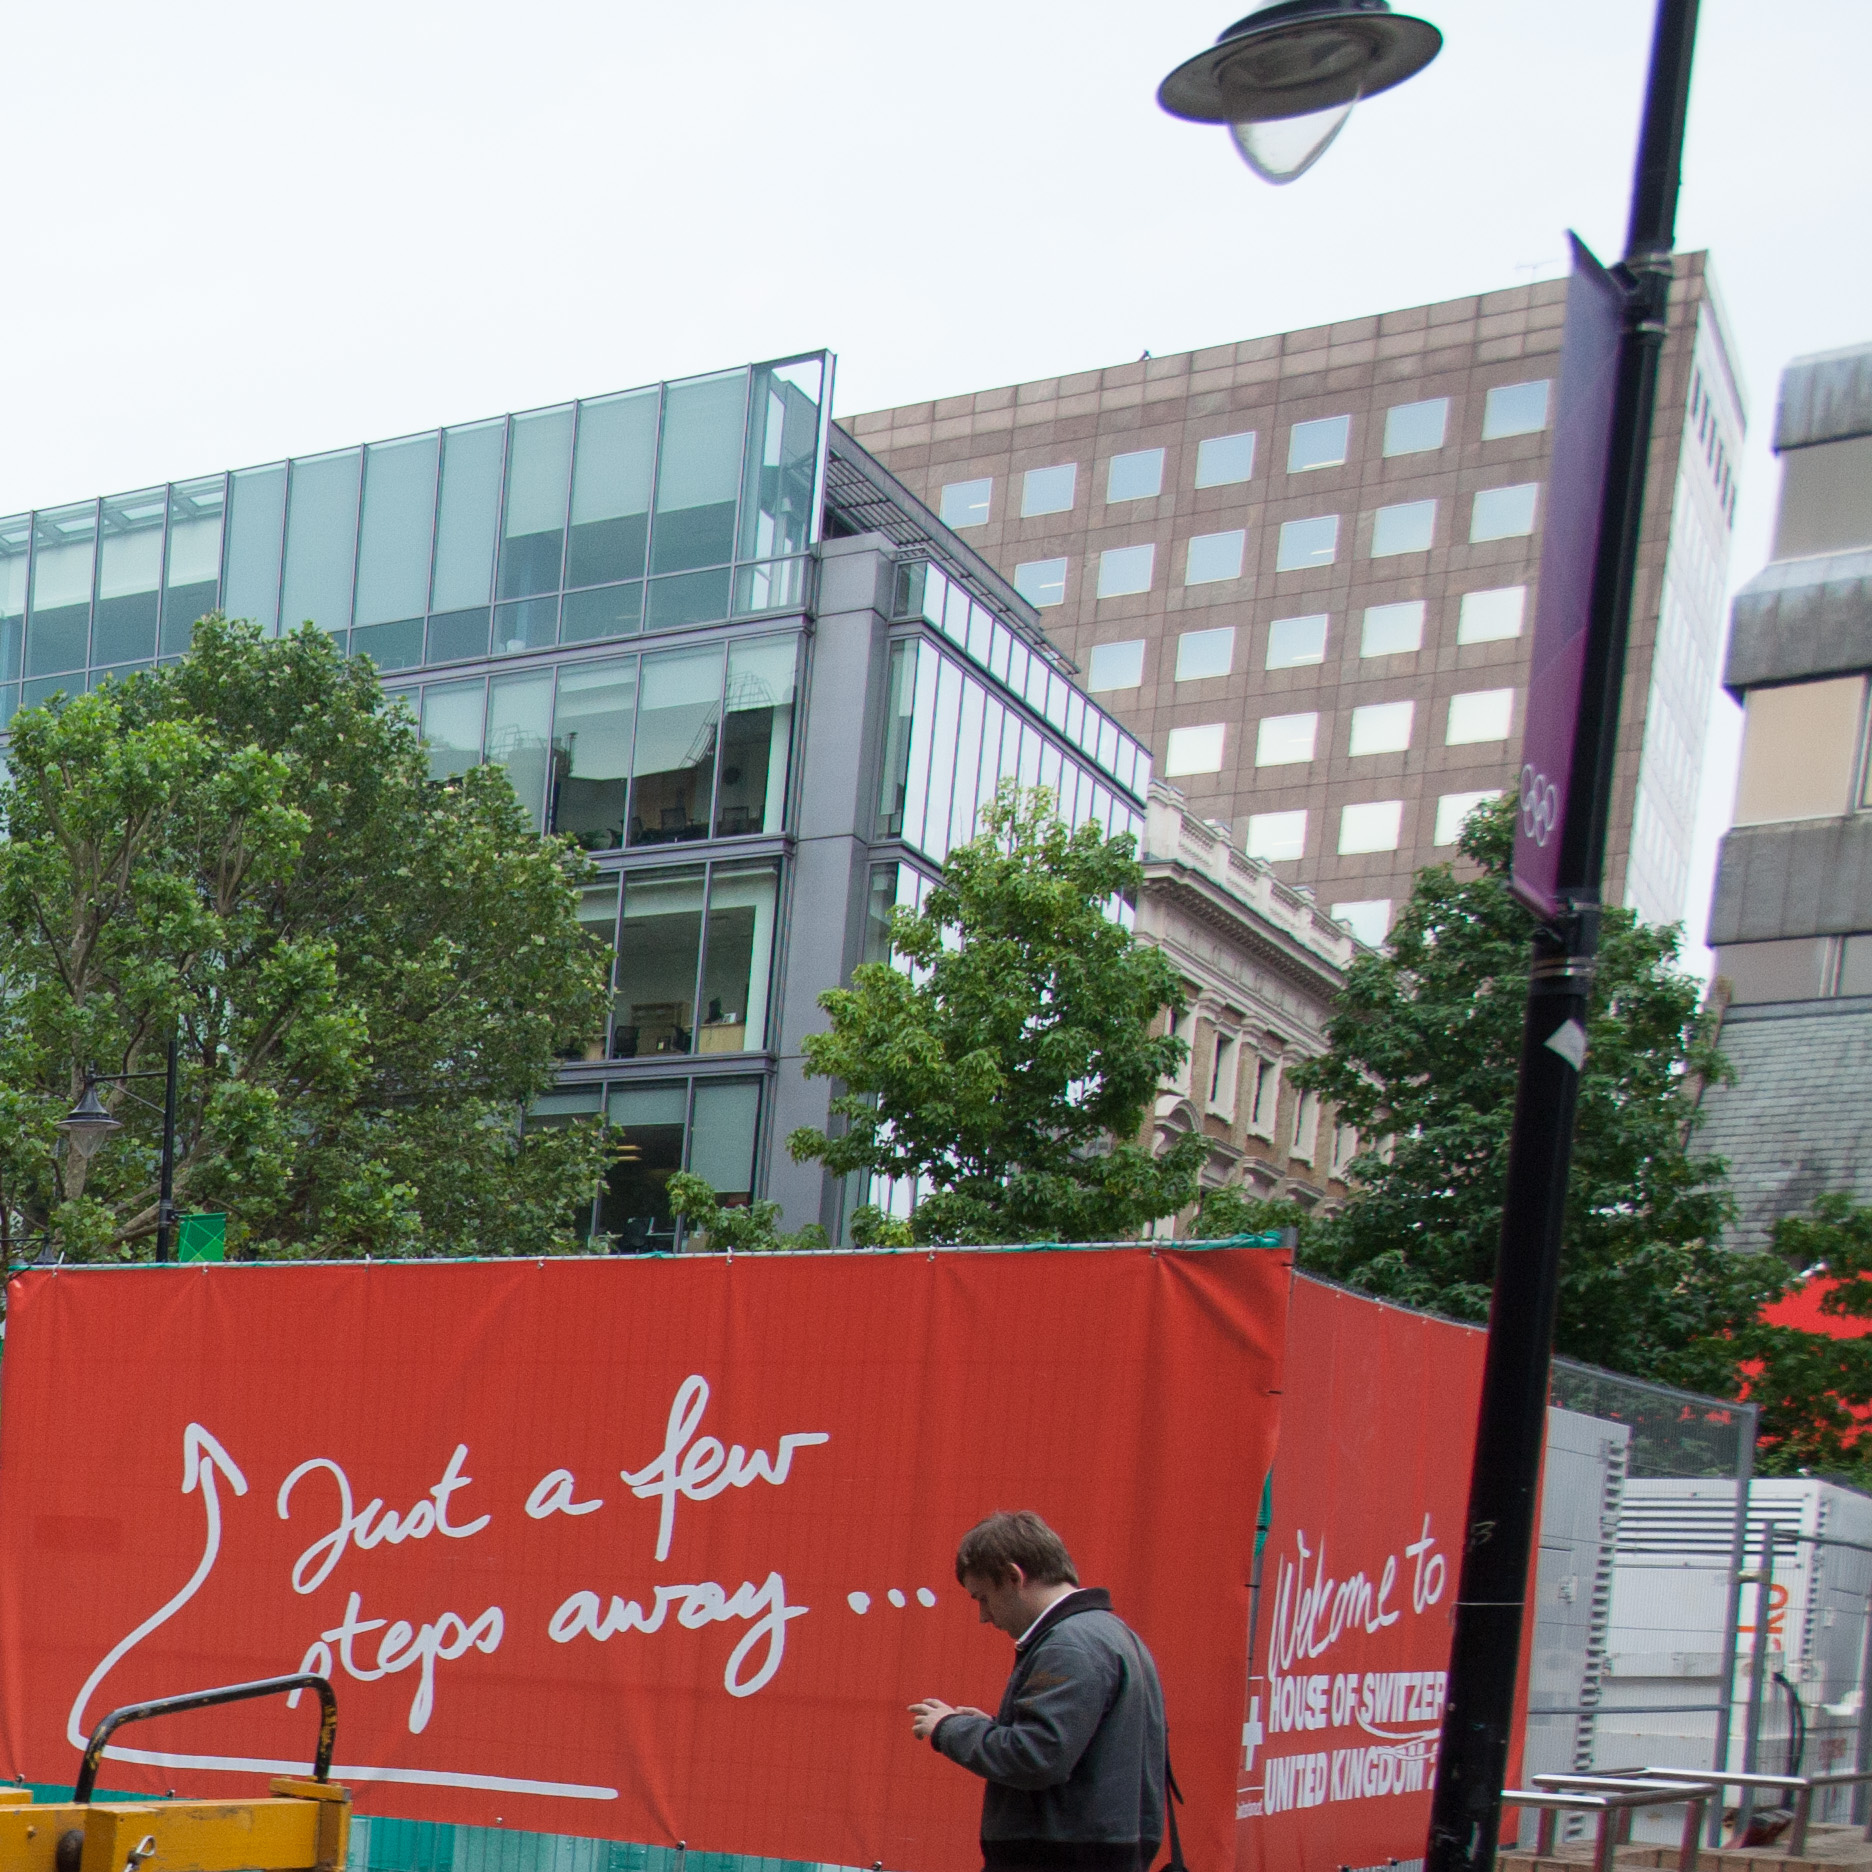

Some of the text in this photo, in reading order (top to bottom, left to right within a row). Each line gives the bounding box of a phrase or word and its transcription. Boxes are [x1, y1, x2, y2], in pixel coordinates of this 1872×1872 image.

[276, 1373, 831, 1596] Just a few
[285, 1590, 505, 1735] steps
[547, 1570, 810, 1699] away
[1268, 1512, 1447, 1683] Welcome to
[1264, 1752, 1329, 1816] UNITED
[1330, 1742, 1427, 1802] KINGDOM
[1269, 1671, 1448, 1734] HOUSE OF SWITZER
